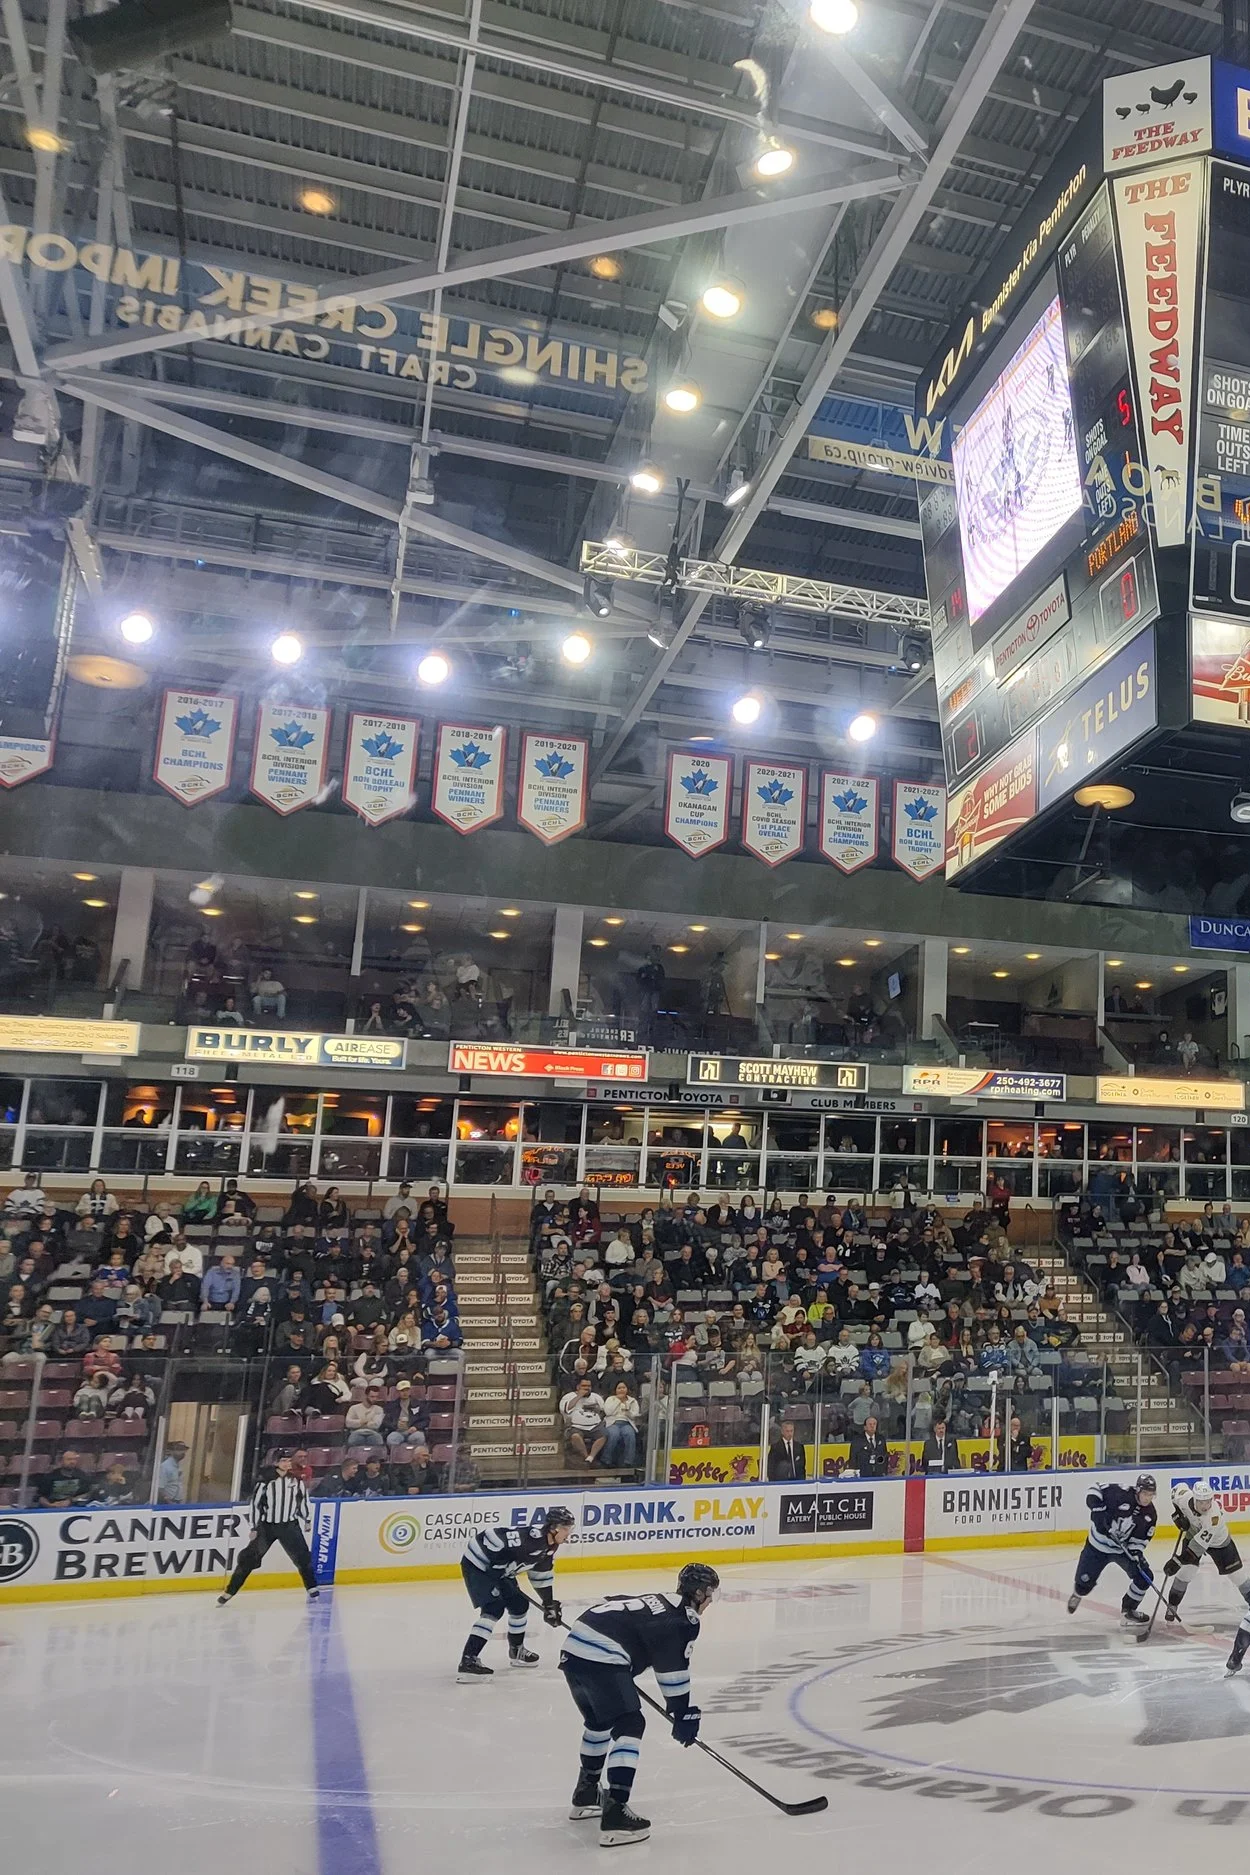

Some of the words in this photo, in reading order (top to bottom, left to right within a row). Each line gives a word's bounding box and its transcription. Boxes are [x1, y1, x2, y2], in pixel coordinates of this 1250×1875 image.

[1134, 121, 1176, 141] THE
[1111, 127, 1204, 161] FEEDWAY
[1124, 171, 1192, 205] THE
[1222, 176, 1250, 199] PLYR
[981, 258, 1022, 333] Bannister
[1022, 236, 1039, 272] Kia
[1039, 163, 1087, 246] Penticton
[1143, 210, 1185, 446] FEEDWAY
[1217, 423, 1250, 446] TIME
[1217, 456, 1250, 476] LEFT
[177, 695, 225, 709] 2016-2017
[1081, 660, 1150, 743] TELUS
[362, 718, 406, 731] 2017-2018
[450, 729, 494, 741] 2018-2019
[534, 740, 577, 751] 2019-2020
[180, 749, 208, 760] BCHL
[162, 757, 224, 771] CHAMPIONS
[690, 759, 711, 768] 2020
[365, 765, 395, 779] BCHL
[756, 767, 797, 780] 2020-2021
[903, 786, 940, 796] 2021-2022
[678, 802, 718, 812] OKANAGAN
[689, 811, 705, 819] CUP
[675, 817, 719, 828] CHAMPIONS
[906, 828, 935, 841] BCHL
[828, 837, 870, 848] CHAMPIONS
[196, 1031, 315, 1054] BURLY
[334, 1041, 391, 1055] AIREASE
[453, 1051, 525, 1072] NEWS
[175, 1066, 195, 1076] 118
[738, 1062, 770, 1074] SCOTT
[772, 1063, 818, 1077] MAYHEW
[738, 1074, 817, 1085] CONTRACTING
[996, 1077, 1061, 1088] 250-492-3677
[603, 1089, 670, 1101] PENTICTON
[990, 1086, 1061, 1096] rprheating.com
[810, 1099, 839, 1109] CLUB
[669, 1463, 729, 1486] Booster
[1208, 1475, 1250, 1491] REAL
[942, 1485, 1062, 1514] BANNISTER
[583, 1501, 685, 1527] DRINK.
[693, 1497, 769, 1522] PLAY.
[788, 1498, 867, 1516] MATCH
[424, 1511, 500, 1526] CASCADES
[786, 1514, 812, 1522] EATERY
[818, 1513, 843, 1521] PUBLIC
[843, 1511, 866, 1519] HOUSE
[953, 1515, 980, 1525] FORD
[992, 1511, 1051, 1524] PENTICTON
[424, 1526, 478, 1541] CASINO
[506, 1528, 522, 1548] 52
[314, 1514, 330, 1574] WINMAR.ca
[53, 1547, 235, 1581] BREWIN
[720, 1731, 1136, 1819] Okanagan
